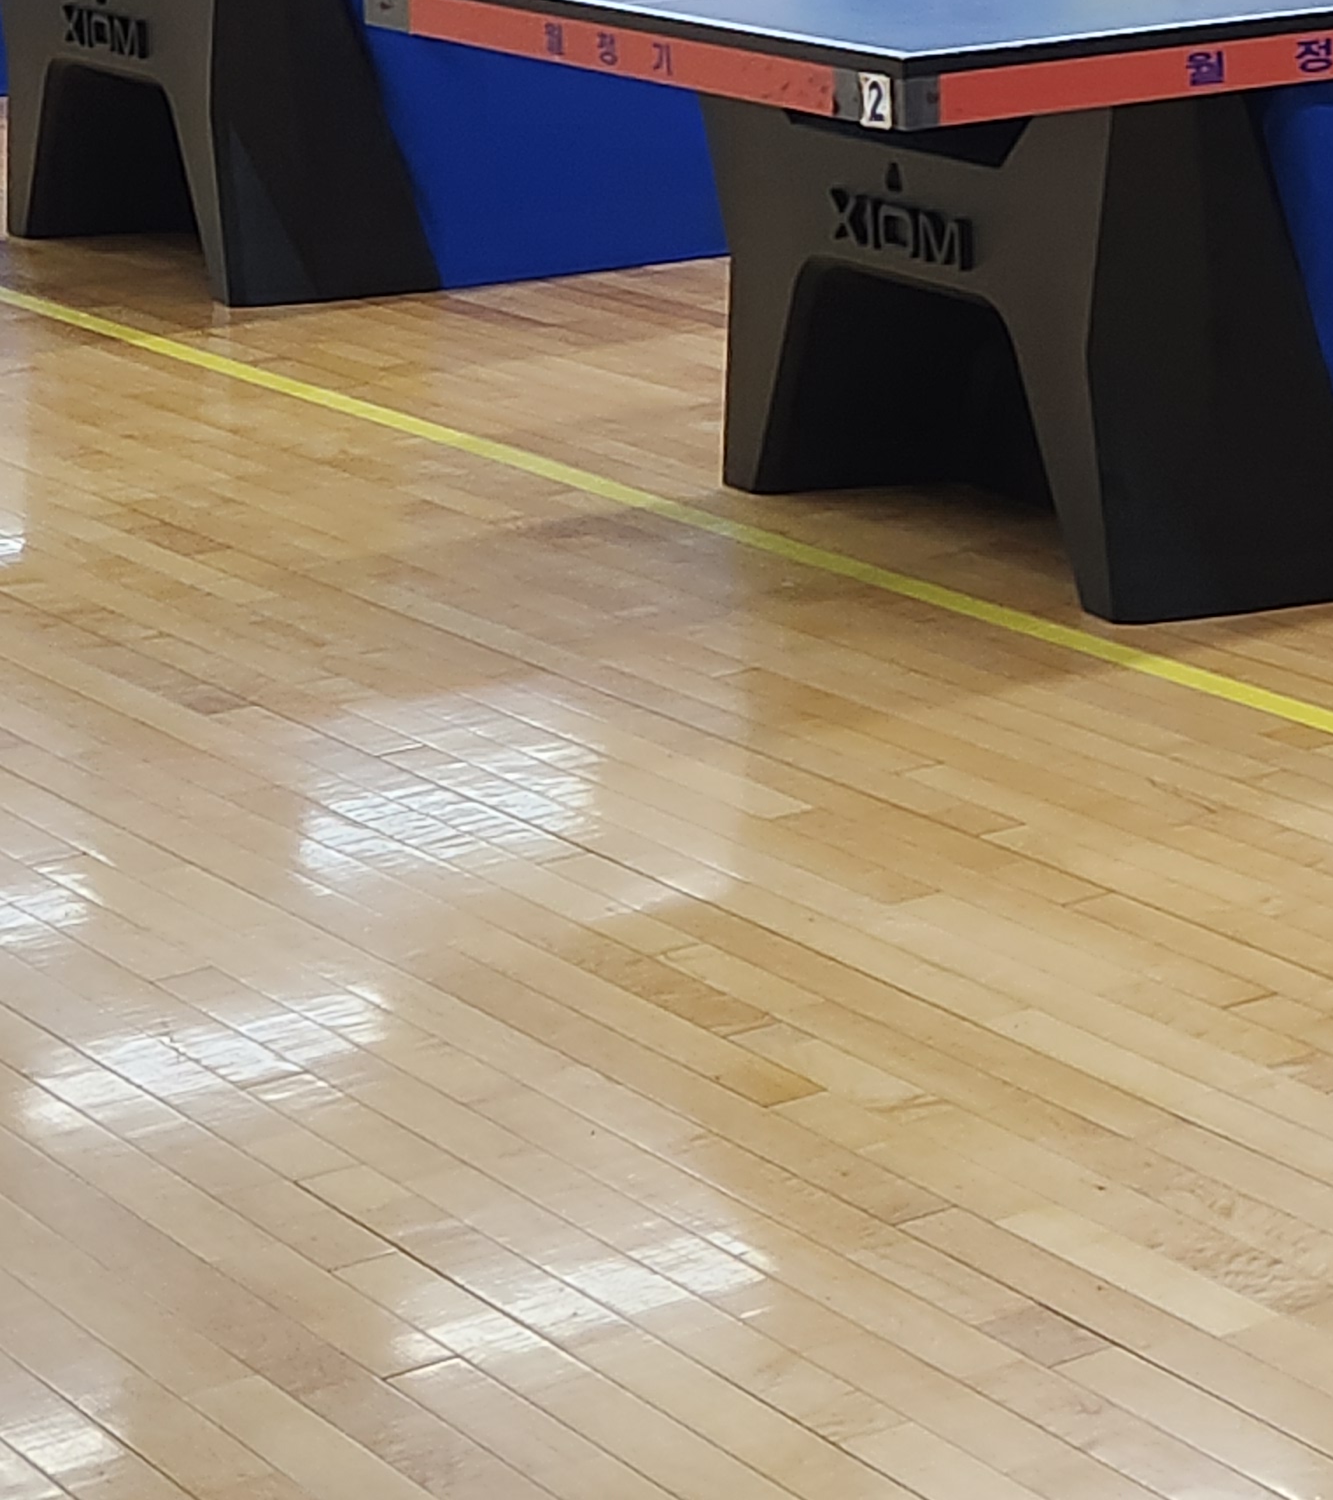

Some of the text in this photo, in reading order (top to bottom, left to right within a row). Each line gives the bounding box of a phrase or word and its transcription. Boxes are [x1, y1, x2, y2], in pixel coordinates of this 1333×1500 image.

[62, 3, 150, 60] XIOM
[868, 79, 885, 122] 2
[830, 187, 974, 271] XIOM
